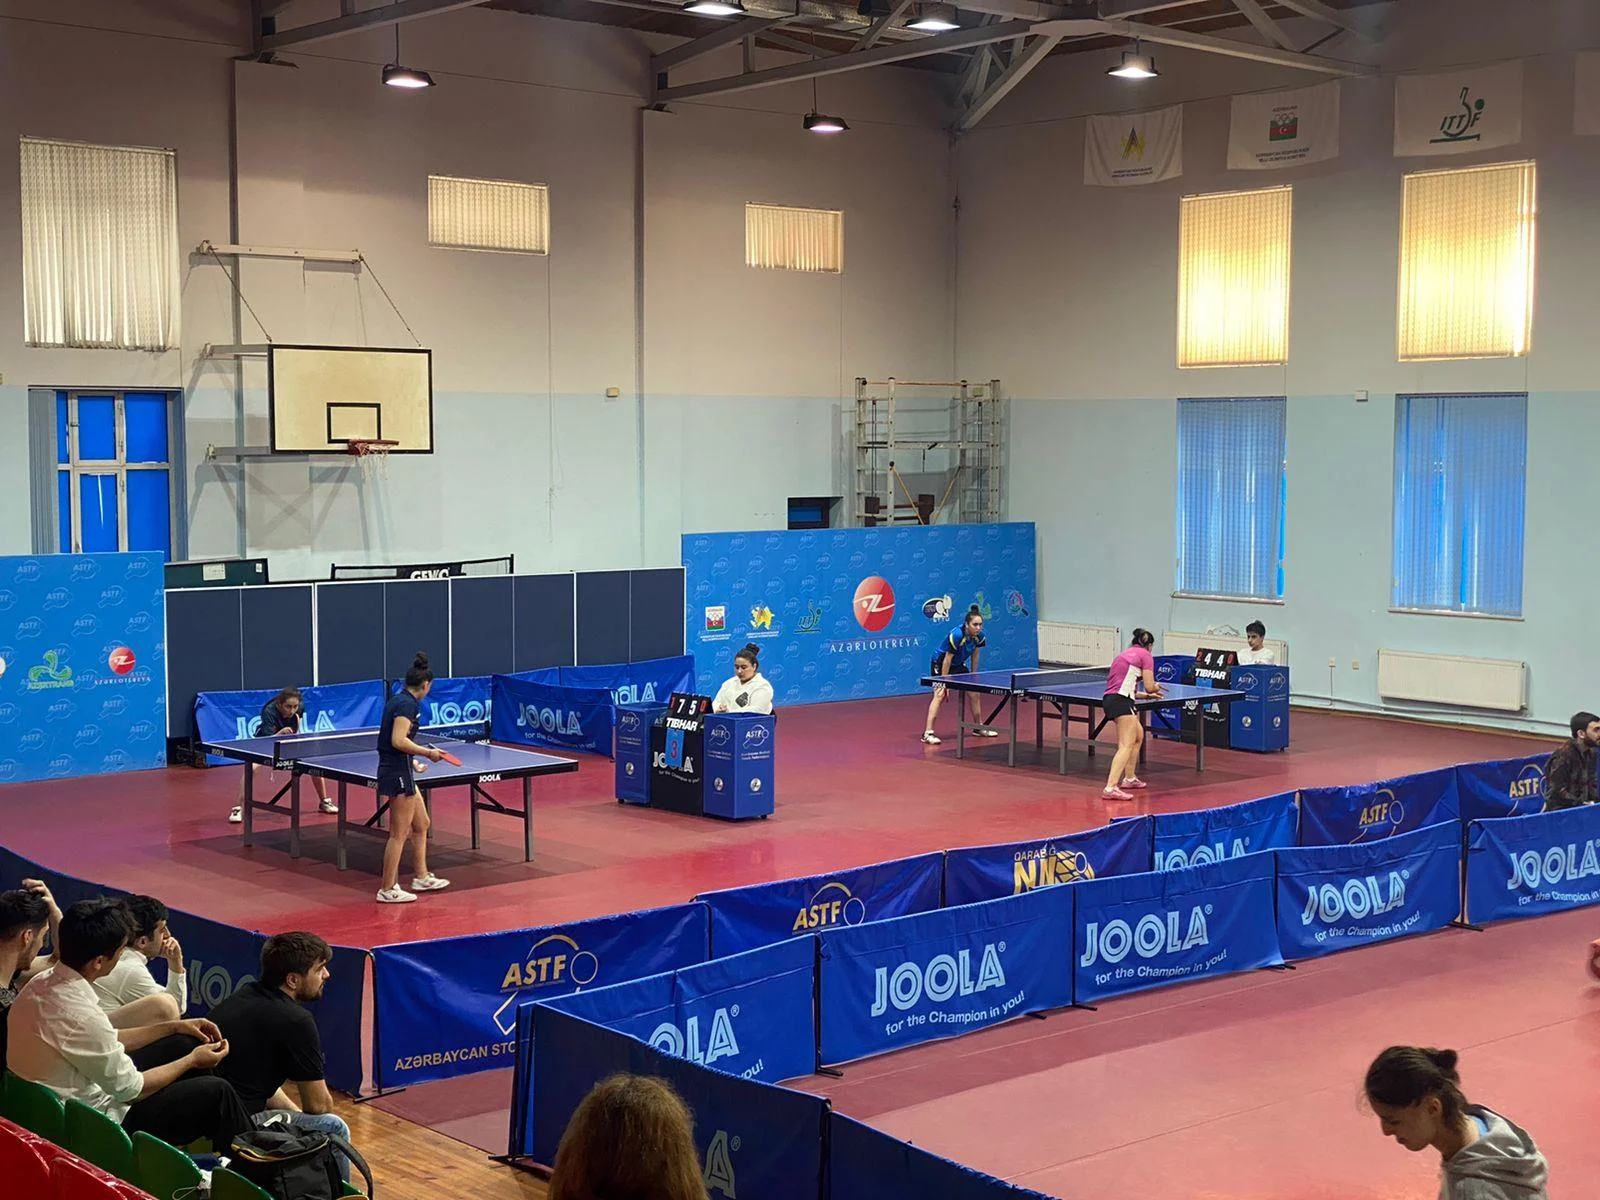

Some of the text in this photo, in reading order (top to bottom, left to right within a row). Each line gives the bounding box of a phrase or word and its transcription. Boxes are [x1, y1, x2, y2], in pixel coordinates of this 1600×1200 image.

[829, 637, 919, 653] AZƏRLOTEREYA
[1204, 652, 1211, 664] 4
[1216, 653, 1224, 667] 4
[1195, 668, 1226, 681] TIBHAR
[677, 699, 685, 714] 7
[688, 700, 697, 715] 5
[666, 717, 698, 732] TIBHAR
[670, 741, 678, 760] 3
[479, 774, 500, 783] JOOLA
[1509, 777, 1539, 798] ASTF
[1358, 803, 1388, 827] ASTF
[792, 901, 842, 932] ASTF
[1314, 931, 1327, 943] for
[1329, 926, 1345, 937] the
[1347, 925, 1392, 938] Champion
[1393, 922, 1402, 933] in
[502, 954, 567, 989] ASTF
[1095, 949, 1227, 986] for the Champion in you!
[885, 990, 1026, 1037] for the Champion in you!
[394, 1044, 488, 1071] AZƏRBAYCAN
